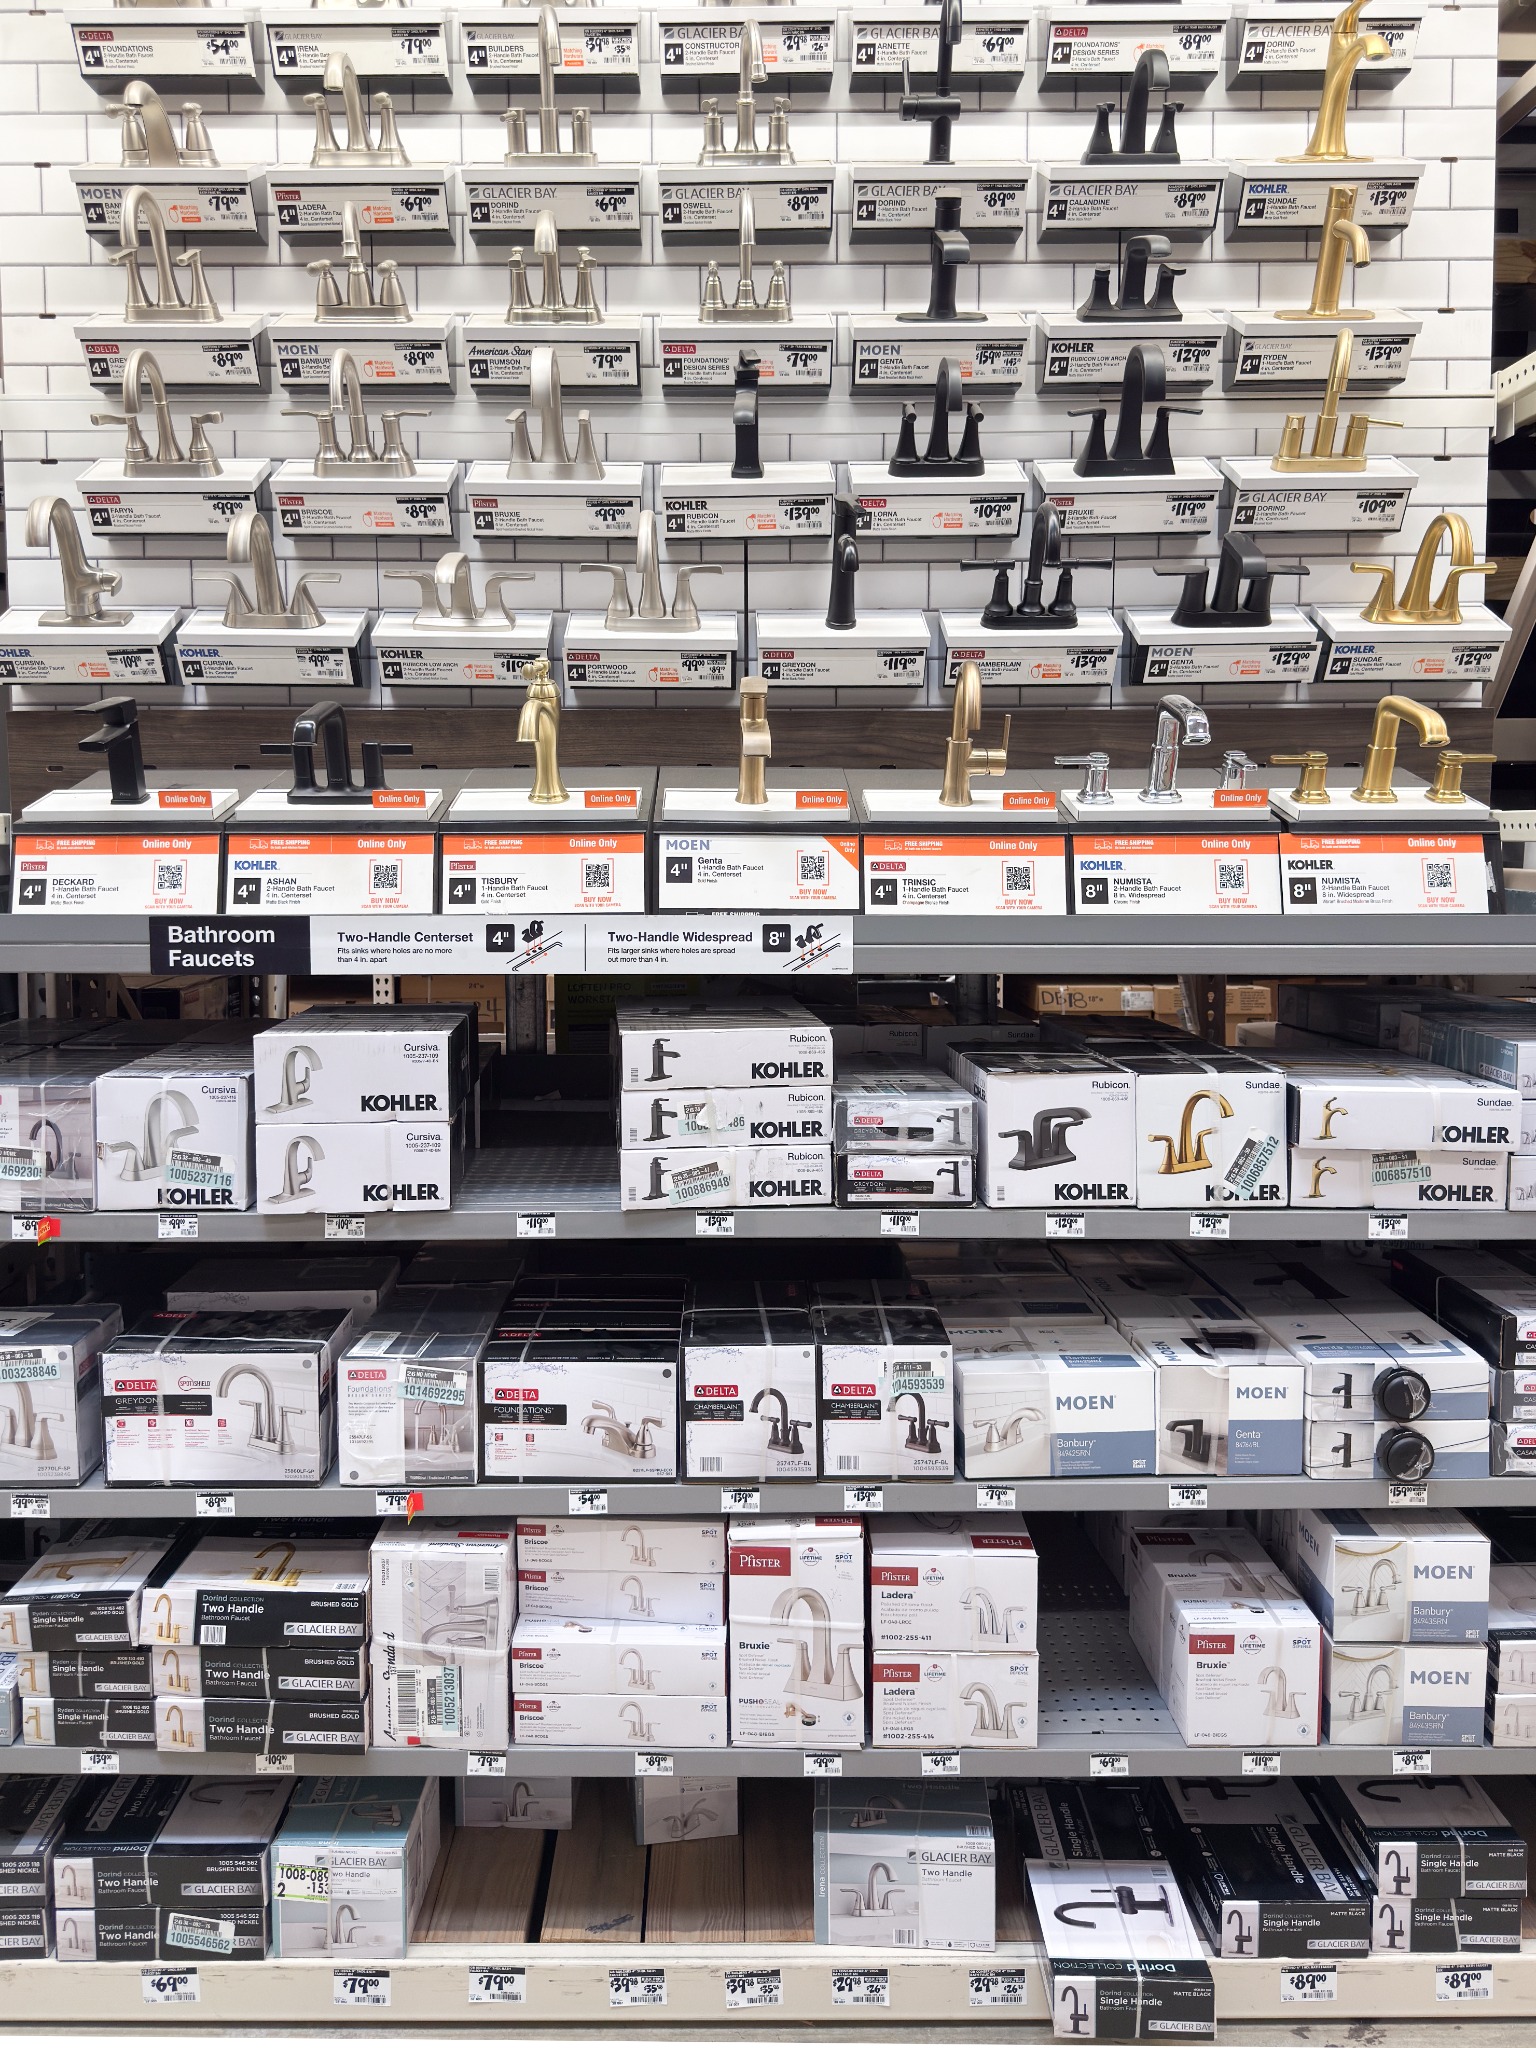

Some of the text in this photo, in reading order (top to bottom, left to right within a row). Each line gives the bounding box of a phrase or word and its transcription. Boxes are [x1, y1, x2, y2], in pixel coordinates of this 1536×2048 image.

[677, 28, 722, 38] GLACIER
[871, 28, 915, 38] GLACIER
[1063, 28, 1086, 36] DELTA
[81, 188, 122, 199] MOEN
[483, 188, 526, 199] GLACIER
[1063, 185, 1108, 196] GLACIER
[1248, 184, 1287, 194] KOHLER
[278, 345, 318, 355] MOEN
[671, 345, 695, 353] DELTA
[860, 345, 900, 355] MOEN
[1051, 343, 1094, 353] KOHLER
[1252, 493, 1300, 503] GLACIER
[666, 501, 707, 510] KOHLER
[179, 648, 219, 658] KOHLER
[381, 650, 423, 659] KOHLER
[1151, 647, 1193, 657] MOEN
[1335, 646, 1375, 654] KOHLER
[165, 795, 206, 805] Online Only
[615, 795, 631, 804] Only
[143, 839, 192, 850] Online Only
[666, 840, 710, 850] MOEN
[234, 861, 277, 870] KOHLER
[1287, 860, 1333, 870] KOHLER
[168, 926, 275, 943] Bathroom
[338, 932, 473, 942] Two-Handle Centerset
[608, 932, 753, 944] Two-Handle Widespread
[169, 950, 254, 967] Faucets
[752, 1062, 824, 1079] KOHLER
[361, 1095, 438, 1111] KOHLER
[751, 1121, 823, 1138] KOHLER
[170, 1168, 231, 1186] 1005237116
[363, 1184, 439, 1201] KOHLER
[1055, 1183, 1129, 1200] KOHLER
[1419, 1185, 1494, 1202] KOHLER
[158, 1189, 233, 1205] KOHLER
[358, 1371, 385, 1379] DELTA
[127, 1381, 157, 1390] DELTA
[706, 1386, 736, 1395] DELTA
[843, 1386, 873, 1394] DELTA
[404, 1386, 465, 1402] 1014692295
[507, 1390, 536, 1399] DELTA
[1236, 1387, 1286, 1399] MOEN
[1056, 1395, 1114, 1410] MOEN
[1414, 1566, 1473, 1579] MOEN
[202, 1604, 263, 1613] Two Handle
[33, 1616, 55, 1624] Single
[297, 1624, 336, 1634] GLACIER
[739, 1641, 770, 1649] Bruxie
[1411, 1671, 1470, 1684] MOEN
[922, 1851, 968, 1863] GLACIER
[922, 1869, 972, 1877] Two Handle
[98, 1878, 158, 1887] Two Handle
[194, 1885, 235, 1894] GLACIER
[1263, 1919, 1288, 1927] Single
[1160, 2022, 1194, 2030] GLACIER
